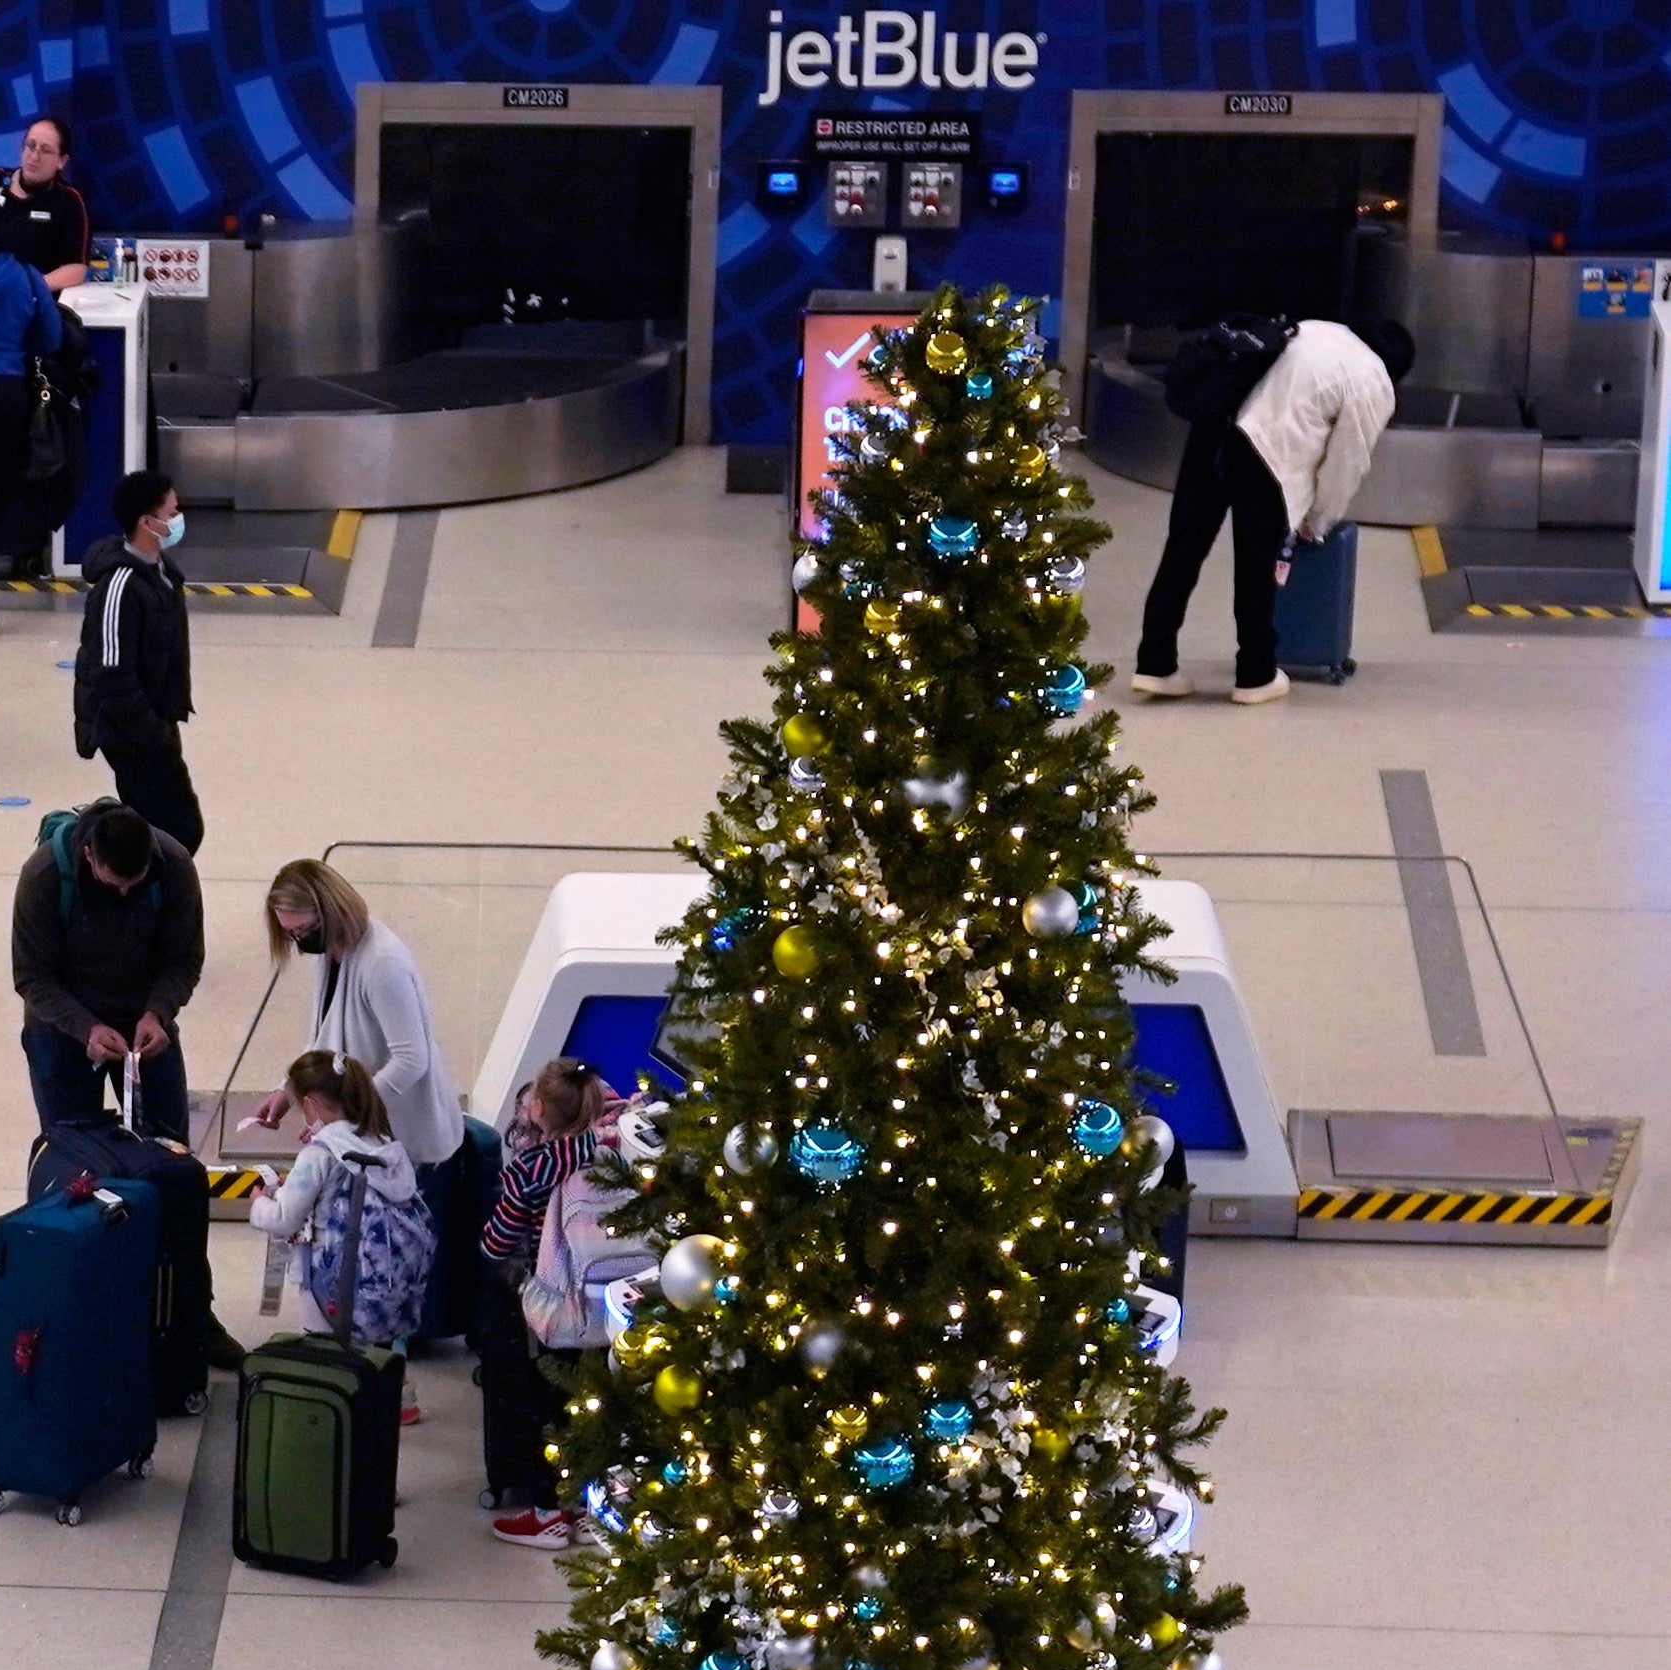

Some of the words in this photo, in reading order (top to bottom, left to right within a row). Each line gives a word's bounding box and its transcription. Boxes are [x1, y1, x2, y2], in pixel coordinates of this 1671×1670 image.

[507, 88, 564, 106] CM2026
[835, 120, 927, 136] RESTRICTED
[929, 121, 970, 136] AREA
